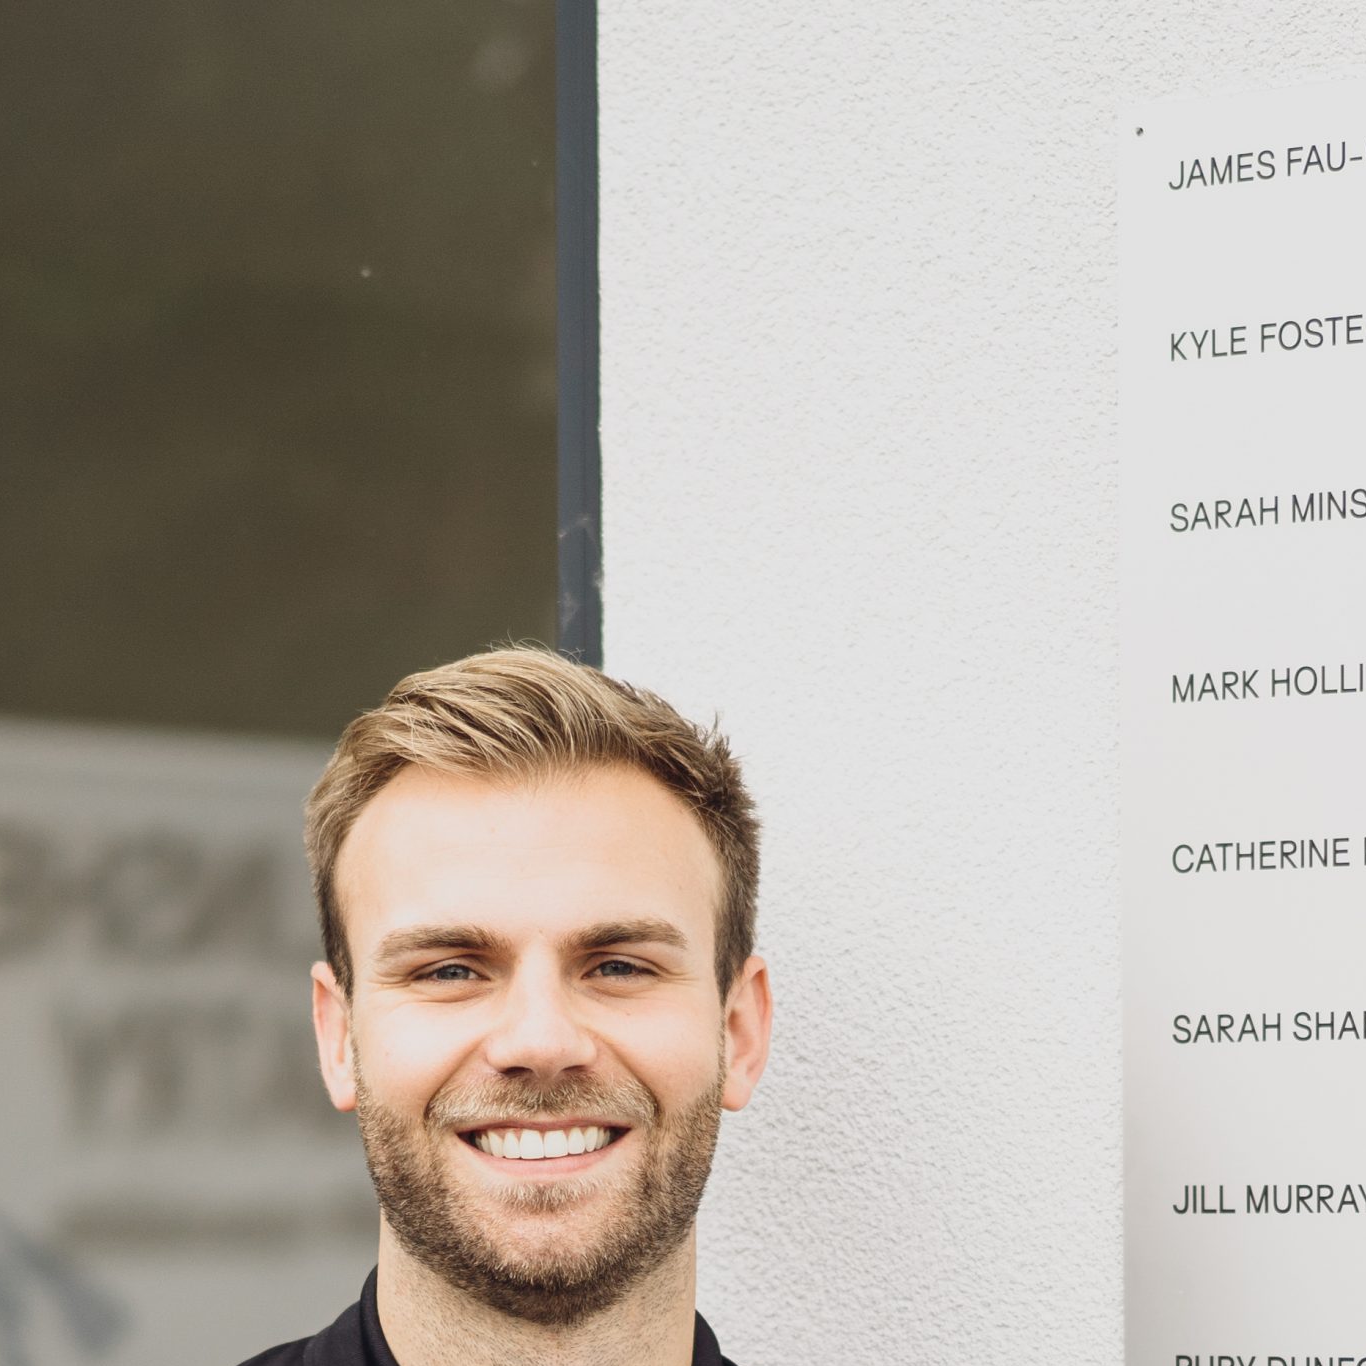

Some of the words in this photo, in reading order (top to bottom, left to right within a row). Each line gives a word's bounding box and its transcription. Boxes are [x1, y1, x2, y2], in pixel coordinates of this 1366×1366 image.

[1168, 149, 1276, 191] JAMES
[1170, 325, 1248, 362] KYLE
[1170, 495, 1279, 533] SARAH
[1172, 669, 1259, 703] MARK
[1172, 837, 1351, 874] CATHERINE
[1172, 1012, 1281, 1044] SARAH
[1172, 1184, 1236, 1215] JILL
